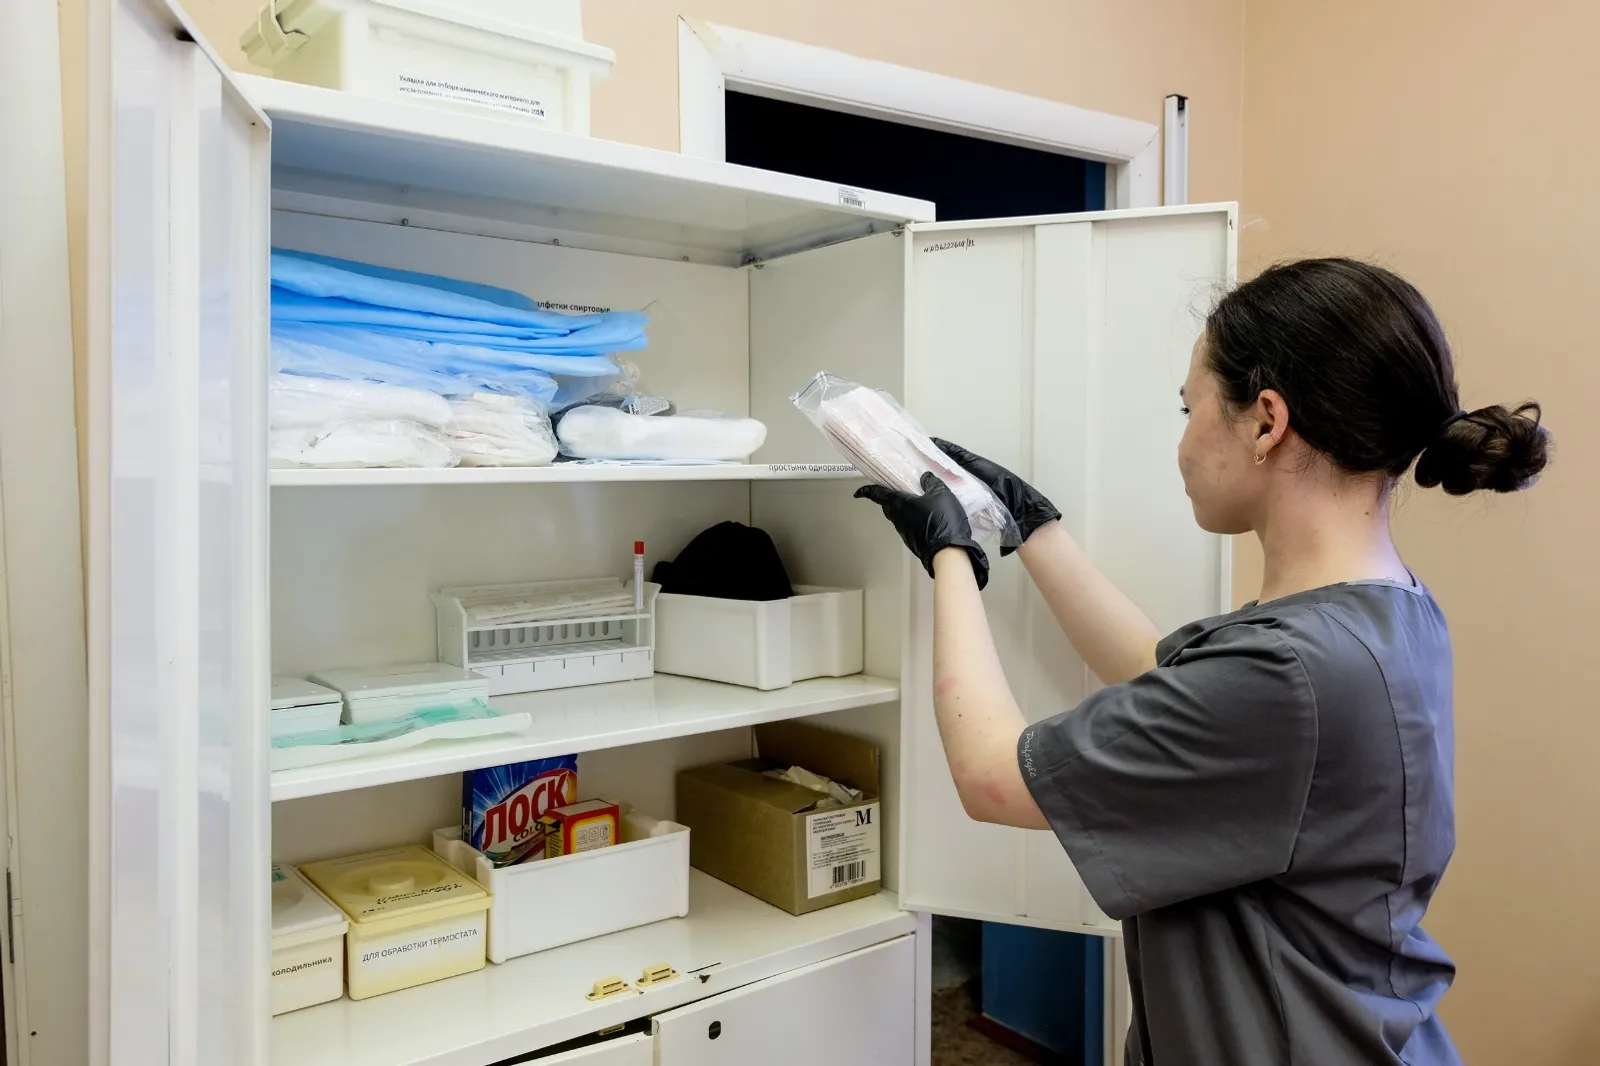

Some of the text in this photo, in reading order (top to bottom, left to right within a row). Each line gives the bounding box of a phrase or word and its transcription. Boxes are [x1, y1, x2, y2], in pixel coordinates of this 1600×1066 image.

[768, 464, 807, 472] простыни
[482, 770, 570, 852] ЛОСК
[855, 808, 873, 827] M
[362, 928, 478, 963] ДЛЯ ОБРАБОТКИ ТЕРМОСТАТА
